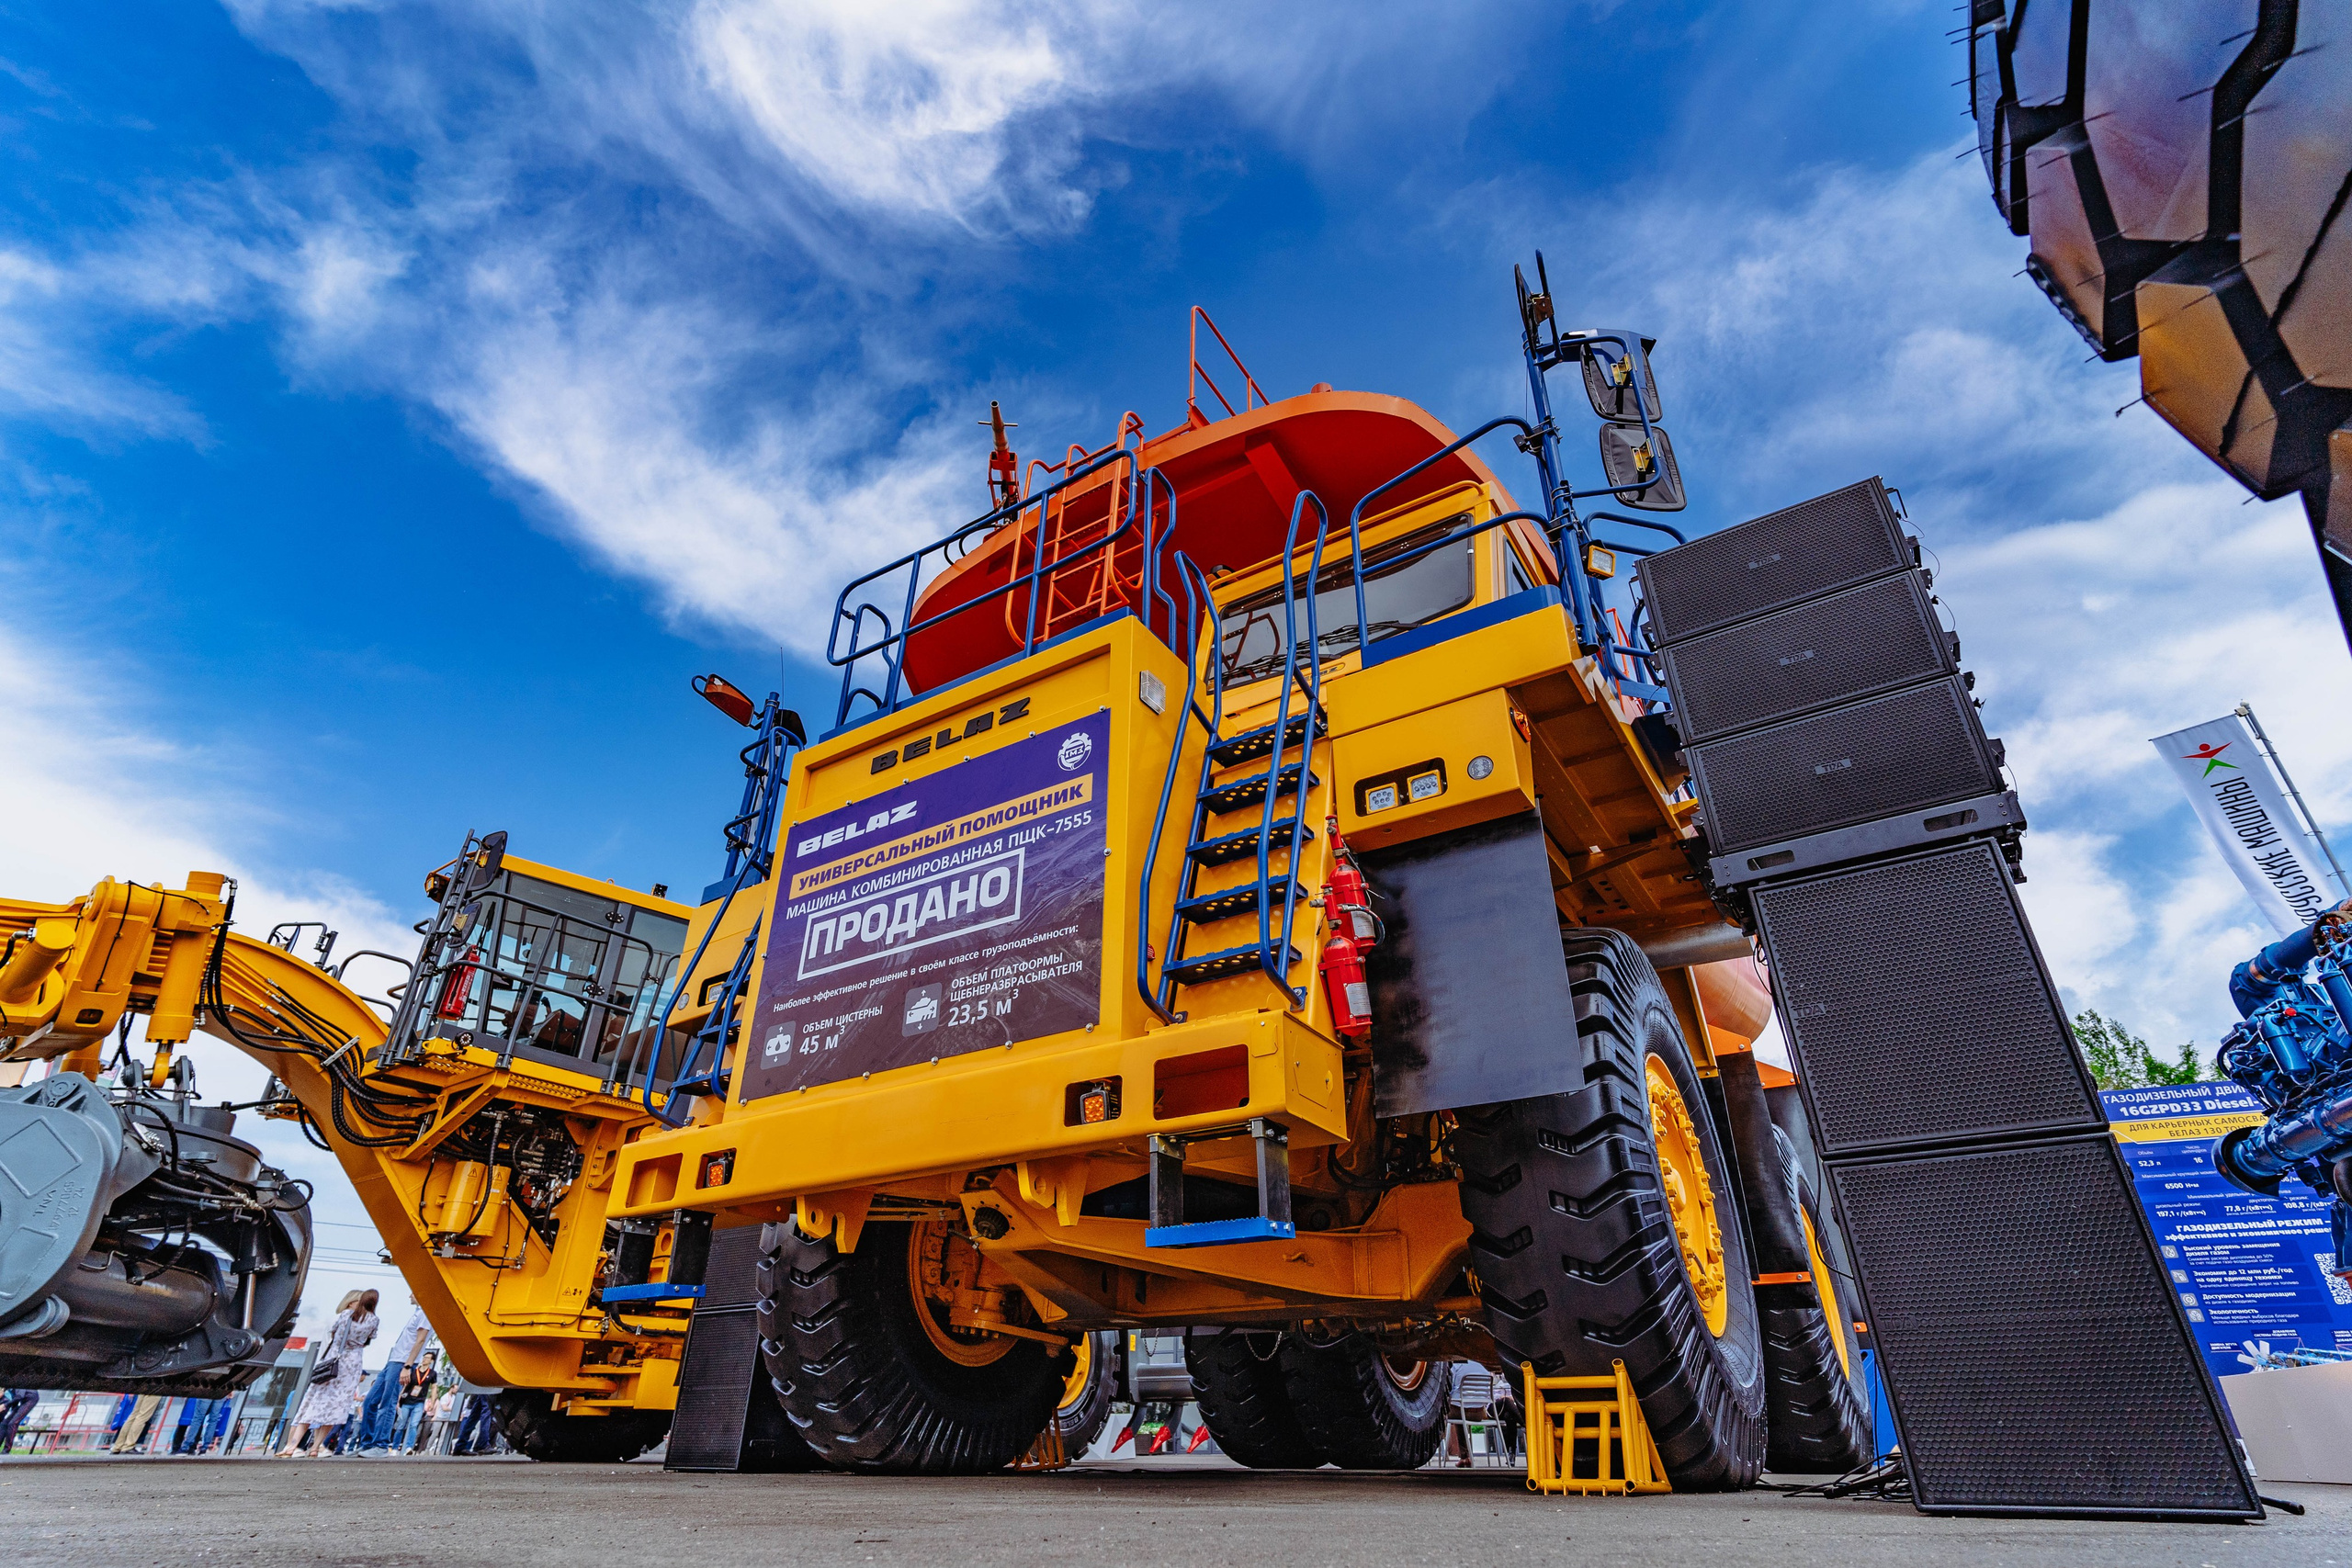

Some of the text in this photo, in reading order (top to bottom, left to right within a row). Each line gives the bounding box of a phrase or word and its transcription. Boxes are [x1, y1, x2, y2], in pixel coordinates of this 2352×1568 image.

[1786, 653, 1808, 662] TDA
[870, 697, 1031, 775] BELAZ
[1821, 761, 1846, 772] TDA
[2210, 776, 2283, 850] МАШИНЫ
[797, 800, 917, 858] BELAZ
[798, 783, 1084, 891] УНИВЕРСАЛЬНЫЙ ПОМОЩНИК
[786, 889, 846, 920] МАШИНА
[851, 838, 1003, 898] КОМБИНИРОВАННАЯ
[808, 866, 1011, 960] ПРОДАНО
[773, 996, 811, 1013] Наиболее
[812, 982, 867, 1002] эффективное
[869, 969, 909, 989] решение
[919, 958, 945, 974] своём
[948, 950, 979, 965] классе
[981, 924, 1080, 957] грузоподъёмности:
[950, 960, 1083, 1002] ЩЕБНЕРАЗБРАСЫВАТЕЛЯ
[951, 953, 1064, 989] ОБЪЕМ ПЛАТФОРМЫ
[802, 1005, 884, 1034] ОБЪЕМ ЦИСТЕРНЫ
[947, 999, 989, 1027] 23,5
[1793, 1005, 1824, 1017] TDA
[799, 1034, 820, 1055] 45
[2102, 1086, 2212, 1104] ГАЗОДИЗЕЛЬНЫЙ
[2119, 1101, 2202, 1117] 16GZPD33
[2129, 1124, 2150, 1133] ДЛЯ
[2151, 1119, 2211, 1131] КАРЬЕРНЫХ
[2169, 1129, 2201, 1137] БЕЛАЗ
[2165, 1231, 2229, 1241] эффективное
[2237, 1229, 2302, 1237] экономичное
[2176, 1219, 2276, 1233] ГАЗОДИЗЕЛЬНЫЙ
[2278, 1218, 2324, 1228] РЕЖИМ
